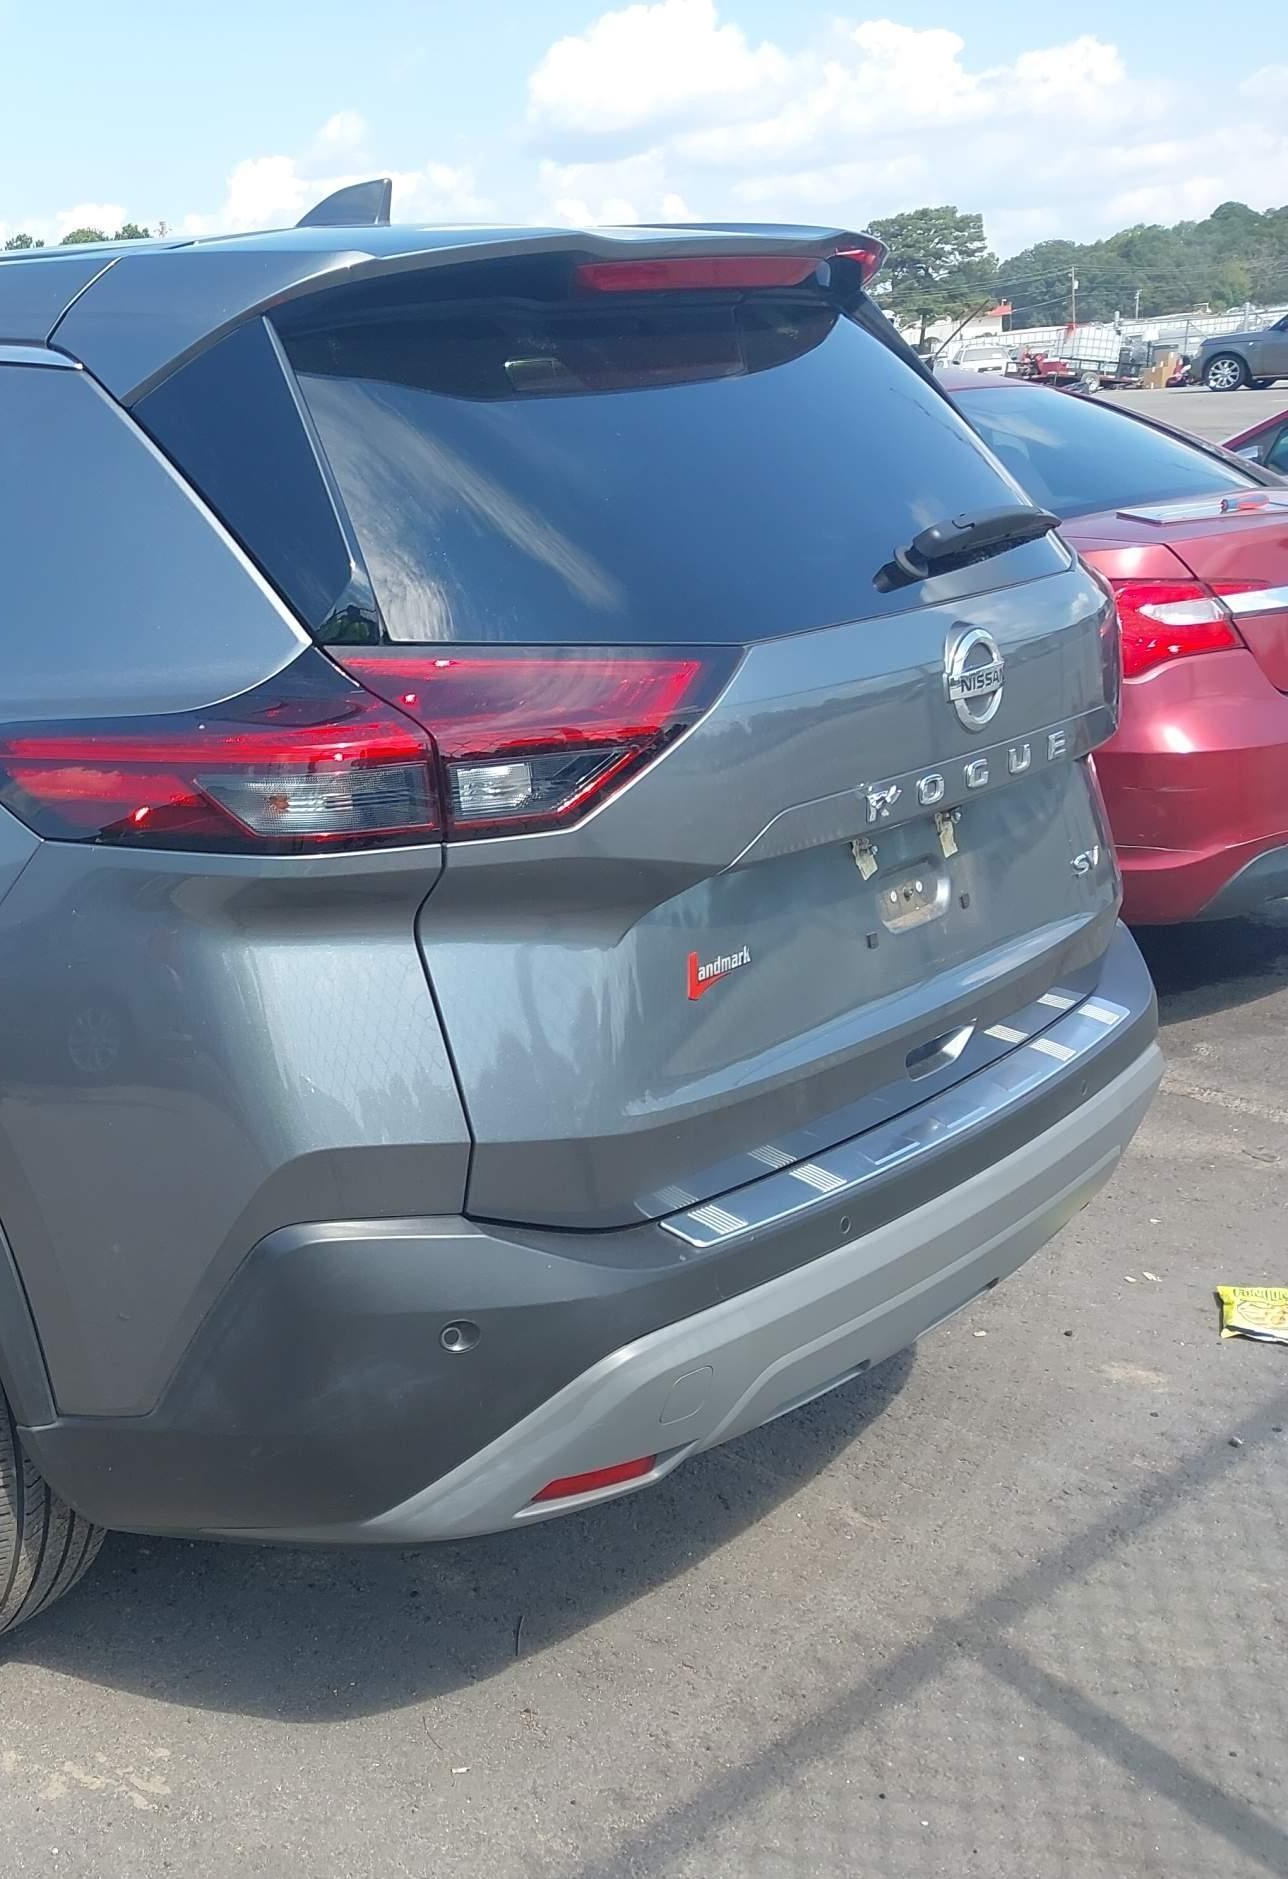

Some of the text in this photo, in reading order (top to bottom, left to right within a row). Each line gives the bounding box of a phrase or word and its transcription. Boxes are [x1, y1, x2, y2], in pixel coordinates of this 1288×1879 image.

[866, 731, 1067, 823] ROGUE
[1073, 844, 1099, 875] SV
[687, 945, 751, 999] Landmark
